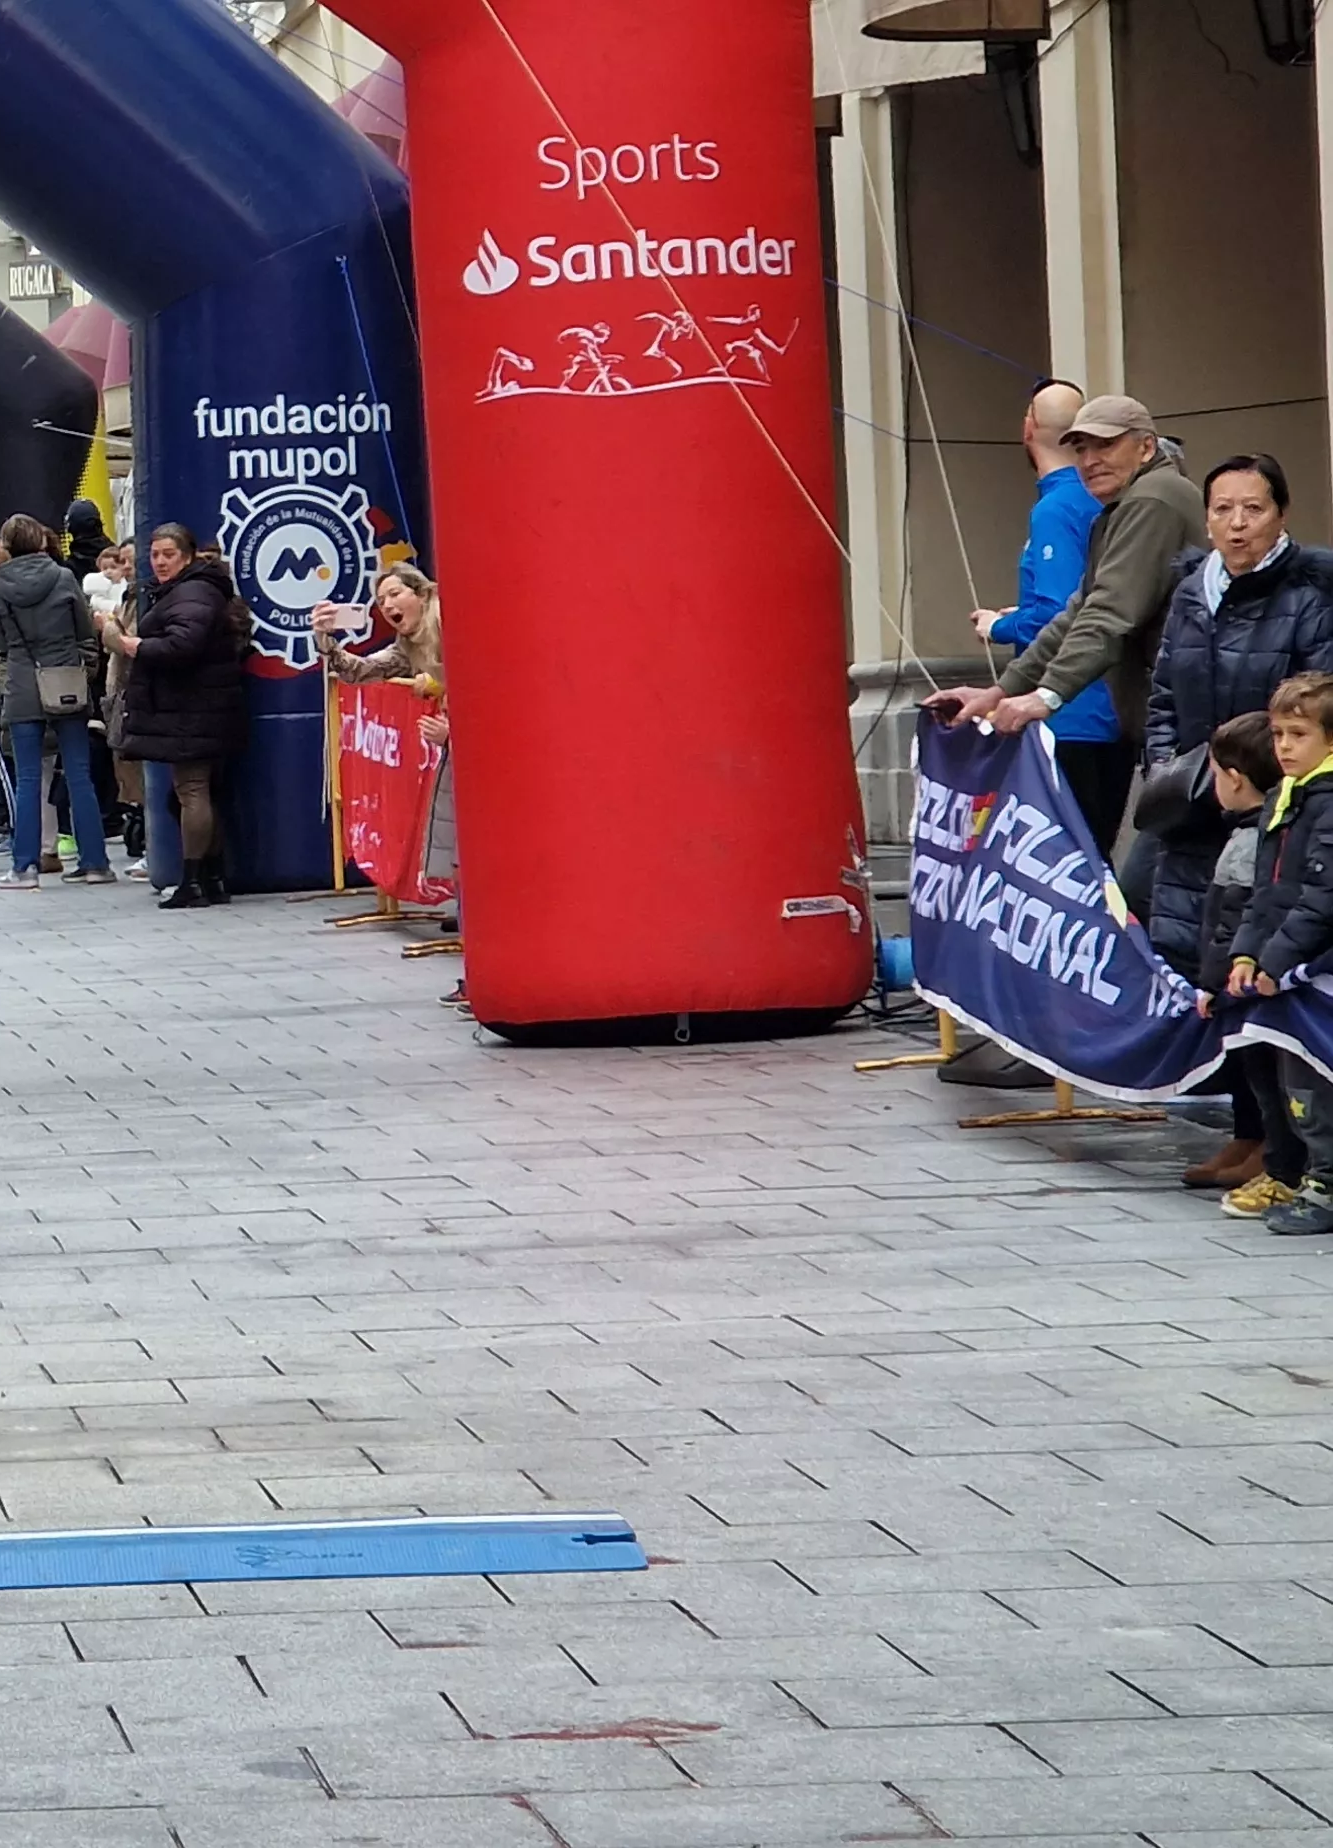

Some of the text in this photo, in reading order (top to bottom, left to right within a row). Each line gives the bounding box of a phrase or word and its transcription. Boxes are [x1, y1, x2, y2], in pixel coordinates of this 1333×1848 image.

[537, 133, 720, 200] Sports
[527, 226, 796, 286] Santander
[193, 392, 391, 438] fundación
[229, 435, 357, 484] mupol
[266, 515, 280, 526] de
[280, 509, 292, 519] la
[269, 608, 313, 627] POLIC
[954, 863, 1121, 1006] NACIONAL
